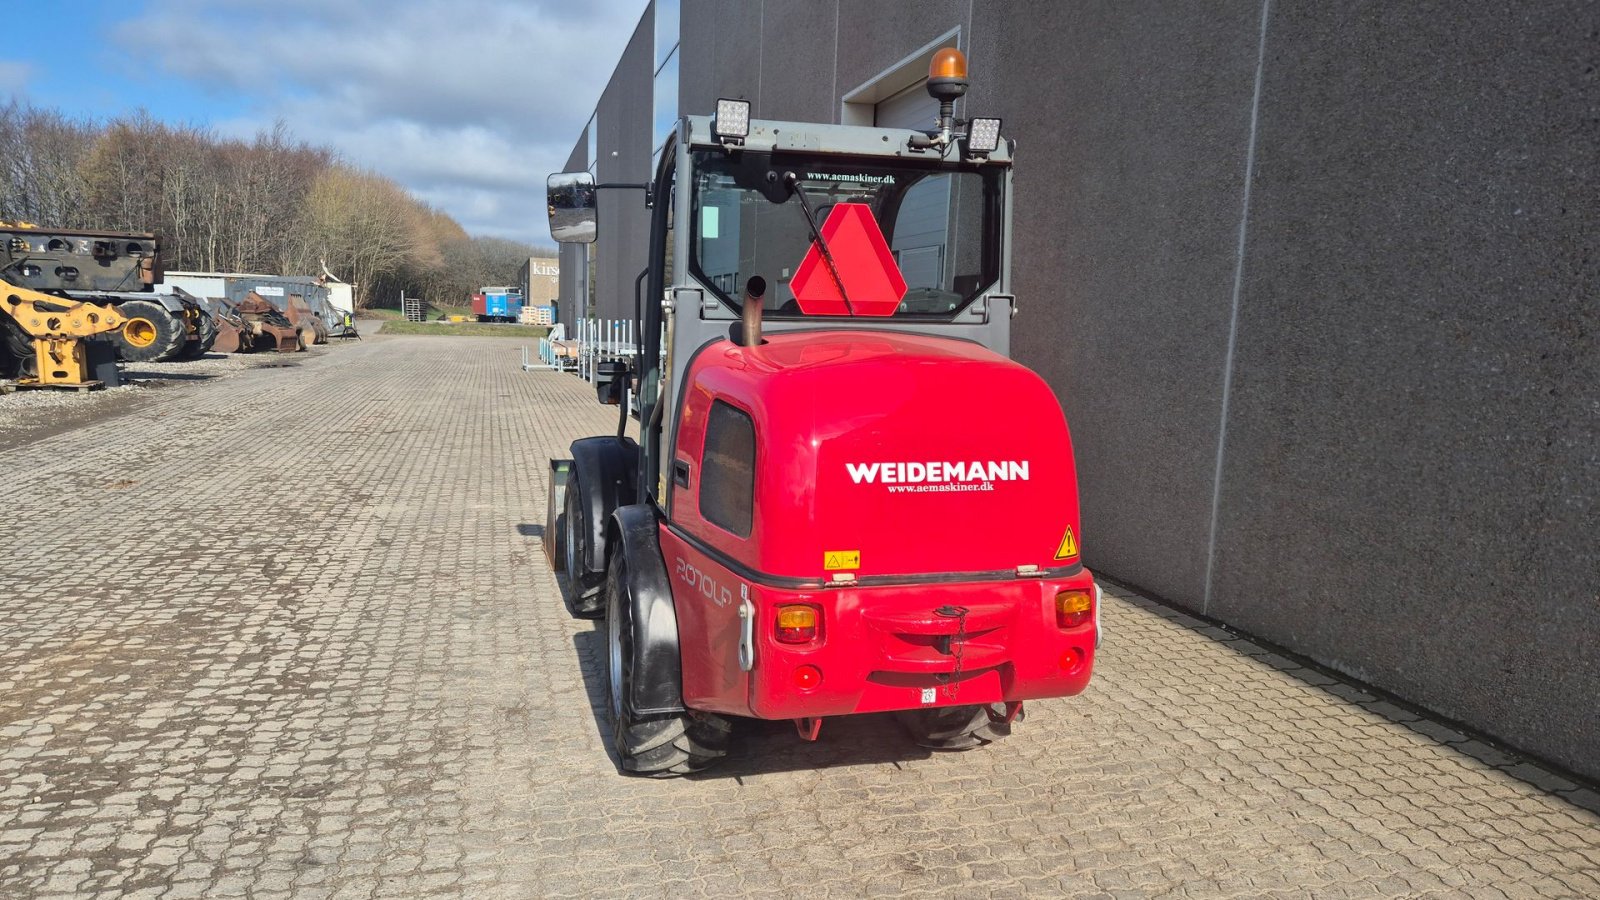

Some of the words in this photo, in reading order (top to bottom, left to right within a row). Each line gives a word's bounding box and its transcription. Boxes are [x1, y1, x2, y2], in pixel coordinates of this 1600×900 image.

[845, 461, 1030, 484] WEIDEMANN
[887, 482, 994, 494] www.aemaskiner.dk
[676, 557, 732, 608] 2070LP
